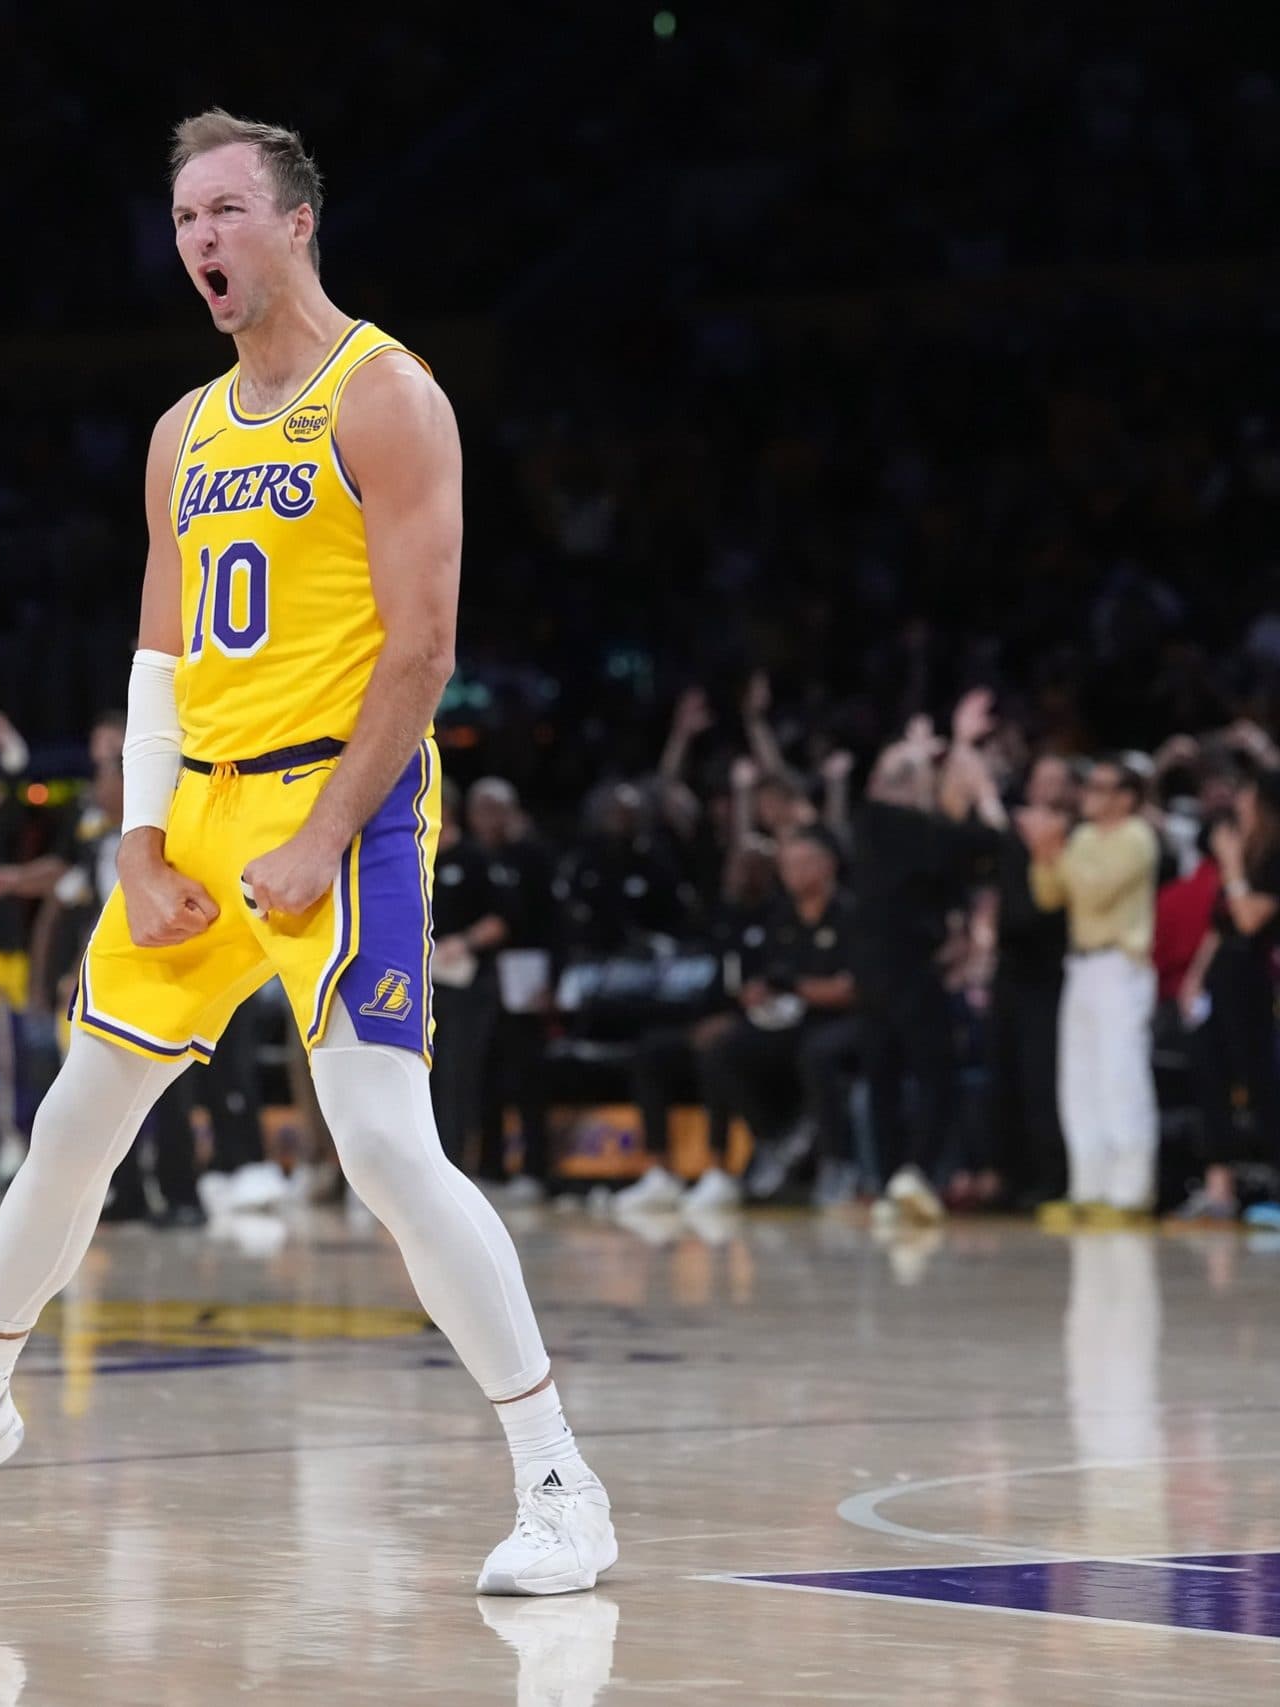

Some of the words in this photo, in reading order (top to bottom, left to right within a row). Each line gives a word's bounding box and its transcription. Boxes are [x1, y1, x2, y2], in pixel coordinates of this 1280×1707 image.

[288, 416, 327, 431] bibigo
[177, 462, 320, 537] LAKERS
[187, 539, 270, 664] 10
